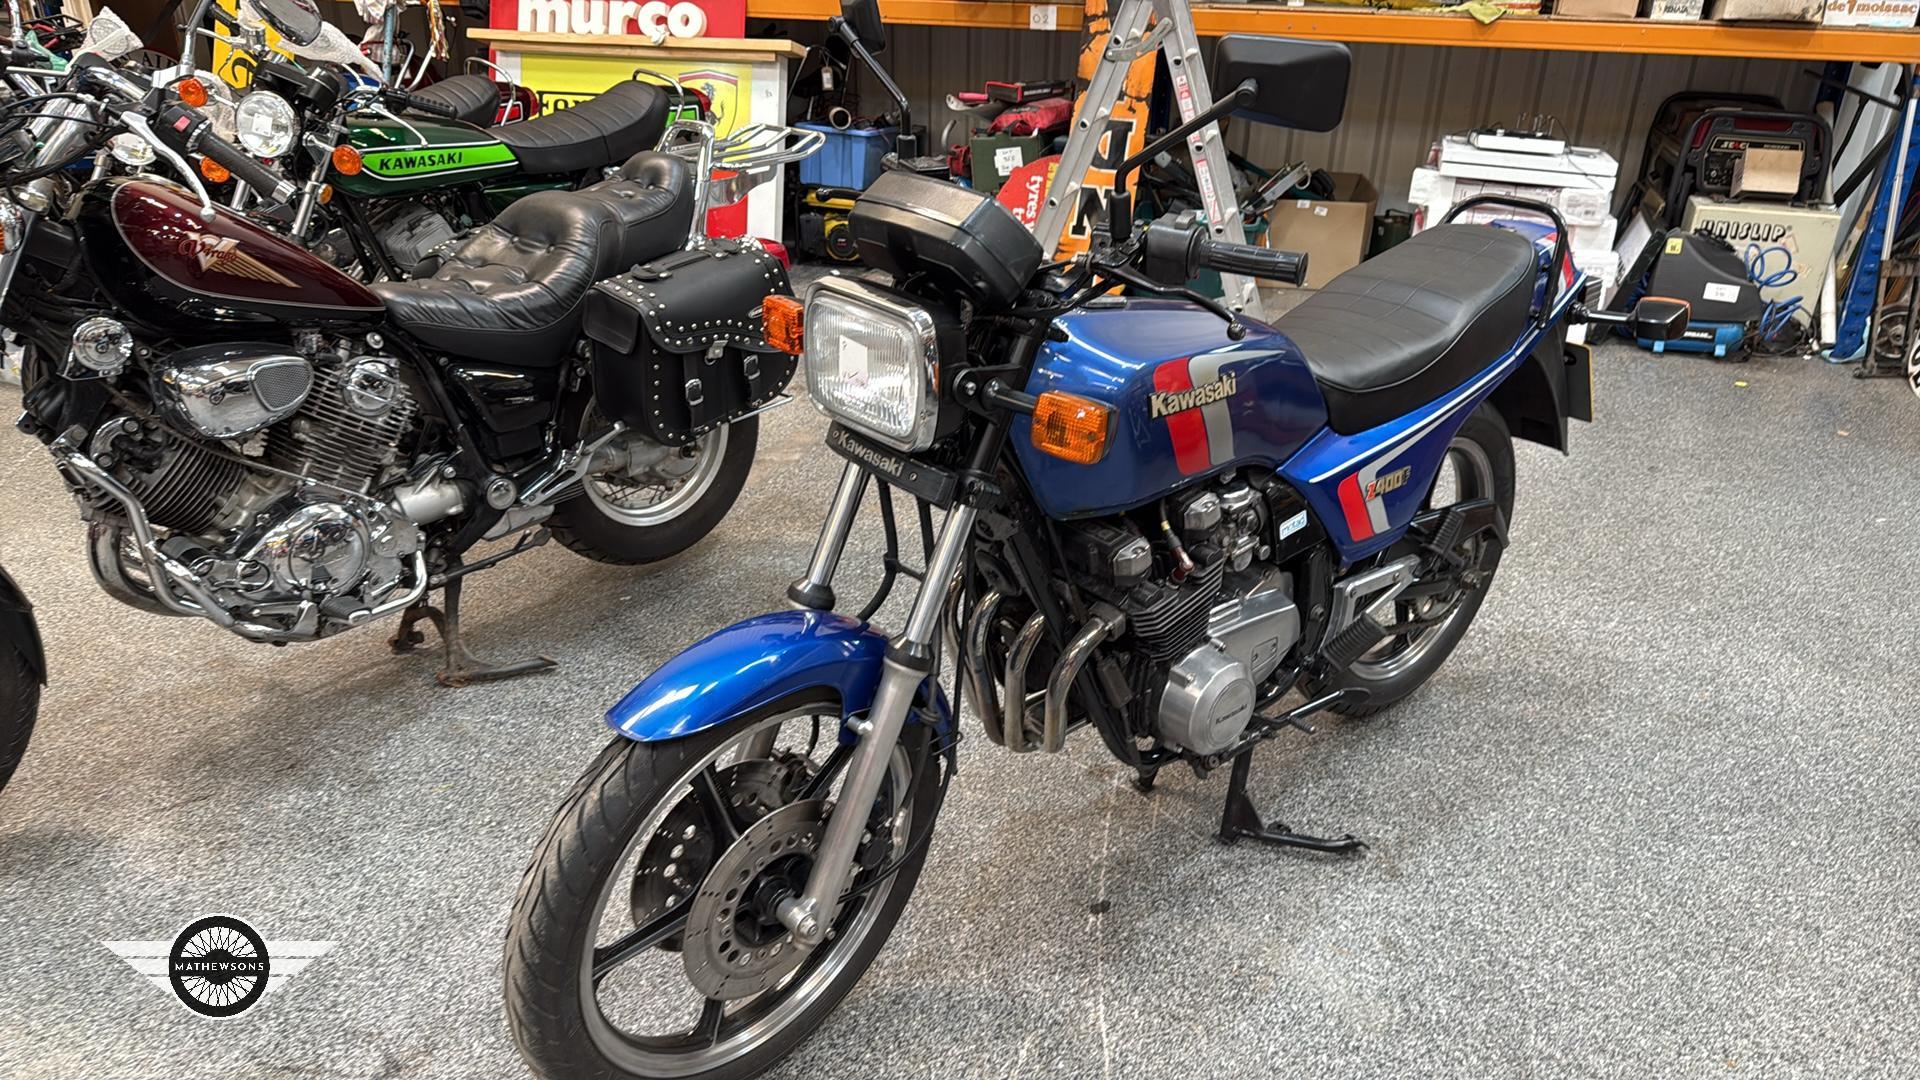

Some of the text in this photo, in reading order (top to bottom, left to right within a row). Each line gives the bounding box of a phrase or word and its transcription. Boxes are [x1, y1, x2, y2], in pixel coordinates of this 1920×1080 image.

[379, 151, 463, 171] KAWASAKI
[1026, 175, 1044, 219] tyres
[1700, 219, 1786, 242] UNISLIP
[1149, 371, 1237, 419] Kawasaki
[838, 430, 904, 478] Kawasaki
